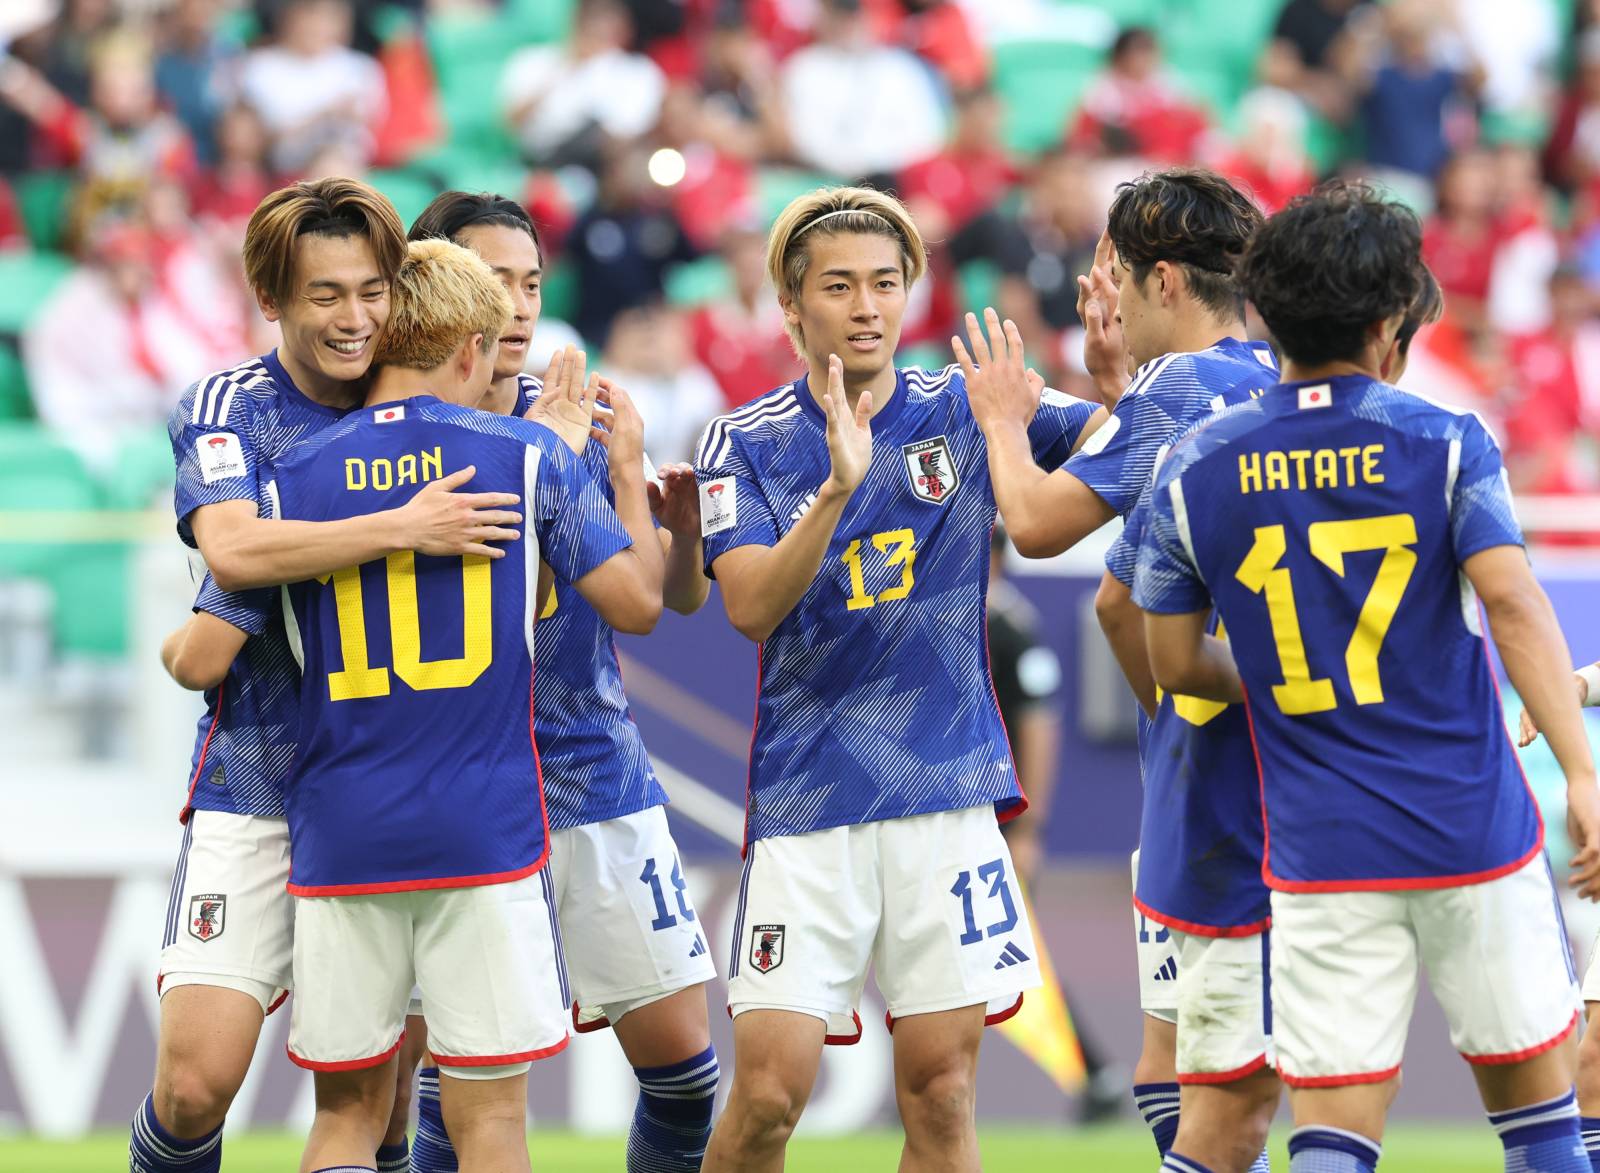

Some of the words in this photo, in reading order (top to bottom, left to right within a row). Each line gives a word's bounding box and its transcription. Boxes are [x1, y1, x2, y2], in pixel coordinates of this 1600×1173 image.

[345, 446, 443, 491] DOAN
[911, 441, 935, 452] JAPAN
[1238, 444, 1386, 494] HATATE
[925, 481, 947, 495] JFA
[840, 528, 916, 611] 13
[315, 545, 493, 702] 10
[1234, 513, 1418, 716] 17
[950, 858, 1019, 946] 13
[756, 958, 773, 966] JFA
